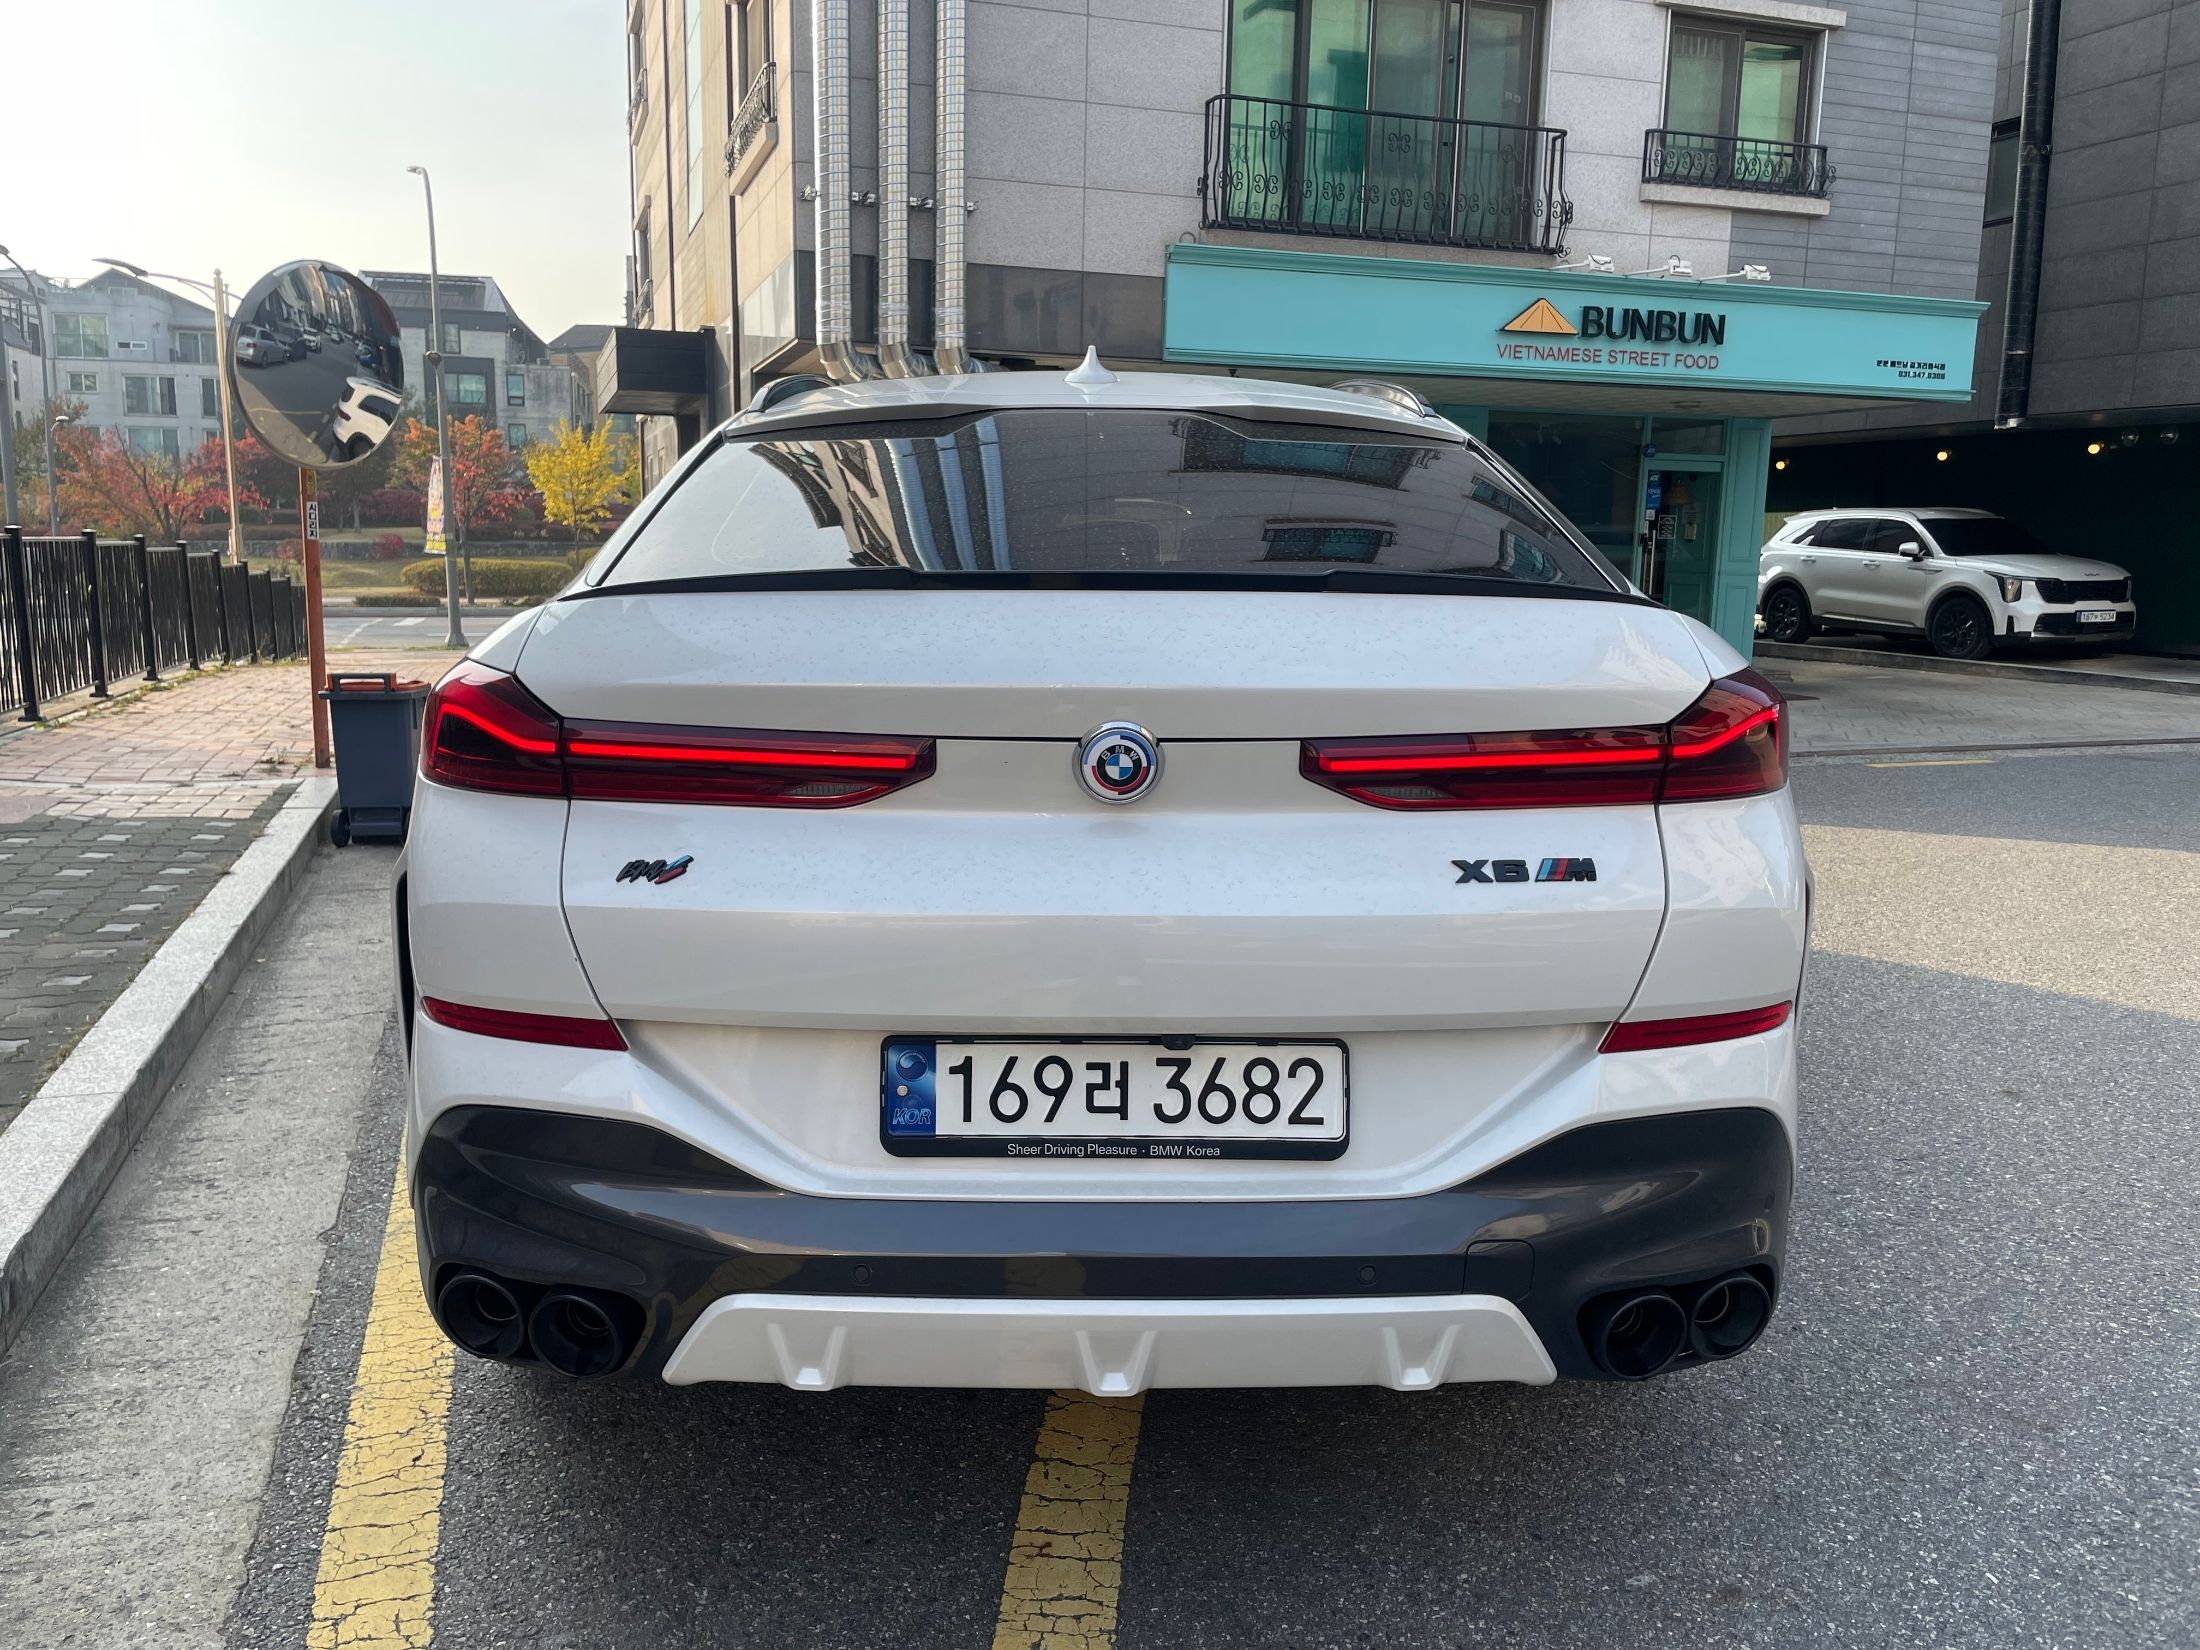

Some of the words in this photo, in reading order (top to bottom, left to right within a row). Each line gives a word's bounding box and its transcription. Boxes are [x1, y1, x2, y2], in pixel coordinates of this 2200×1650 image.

[1581, 305, 1726, 345] BUNBUN
[1497, 344, 1602, 363] VIETNAMESE
[1608, 349, 1670, 367] STREET
[1674, 354, 1719, 370] FOOD
[1101, 745, 1139, 761] BMW
[1451, 859, 1529, 883] X6
[948, 1055, 1129, 1123] 169러
[1153, 1056, 1324, 1125] 3682
[892, 1108, 931, 1125] KOR
[1007, 1143, 1042, 1156] Sheer
[1044, 1143, 1085, 1158] Driving
[1087, 1144, 1138, 1156] Pleasure
[1150, 1145, 1183, 1157] BMW
[1186, 1145, 1220, 1157] Korea
